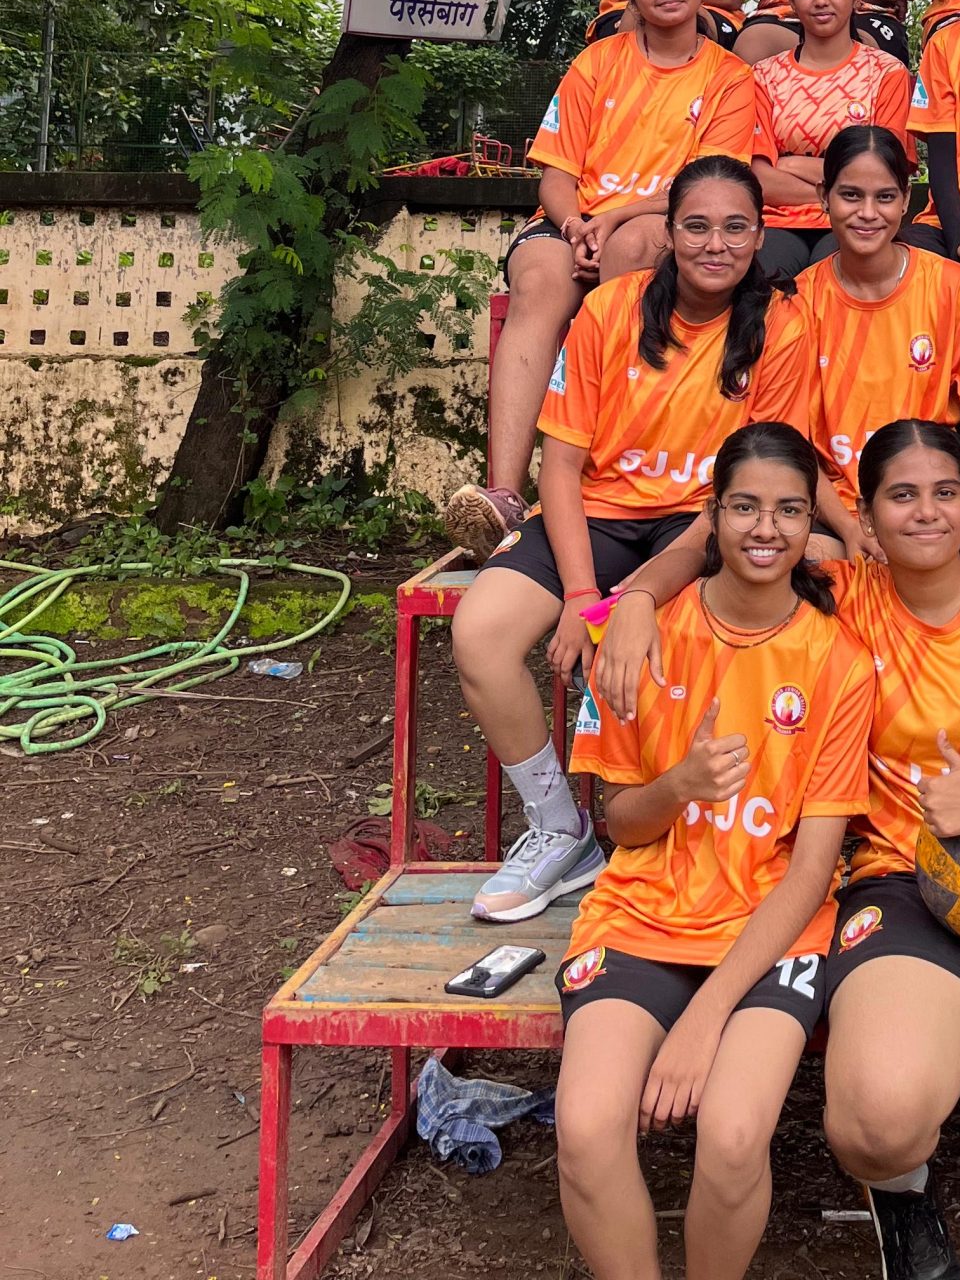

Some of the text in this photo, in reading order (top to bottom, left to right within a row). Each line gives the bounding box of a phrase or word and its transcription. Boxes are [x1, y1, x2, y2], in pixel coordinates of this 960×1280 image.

[869, 18, 894, 41] 18
[619, 448, 717, 486] SJJC
[683, 792, 775, 838] JC
[775, 953, 820, 1001] 12
